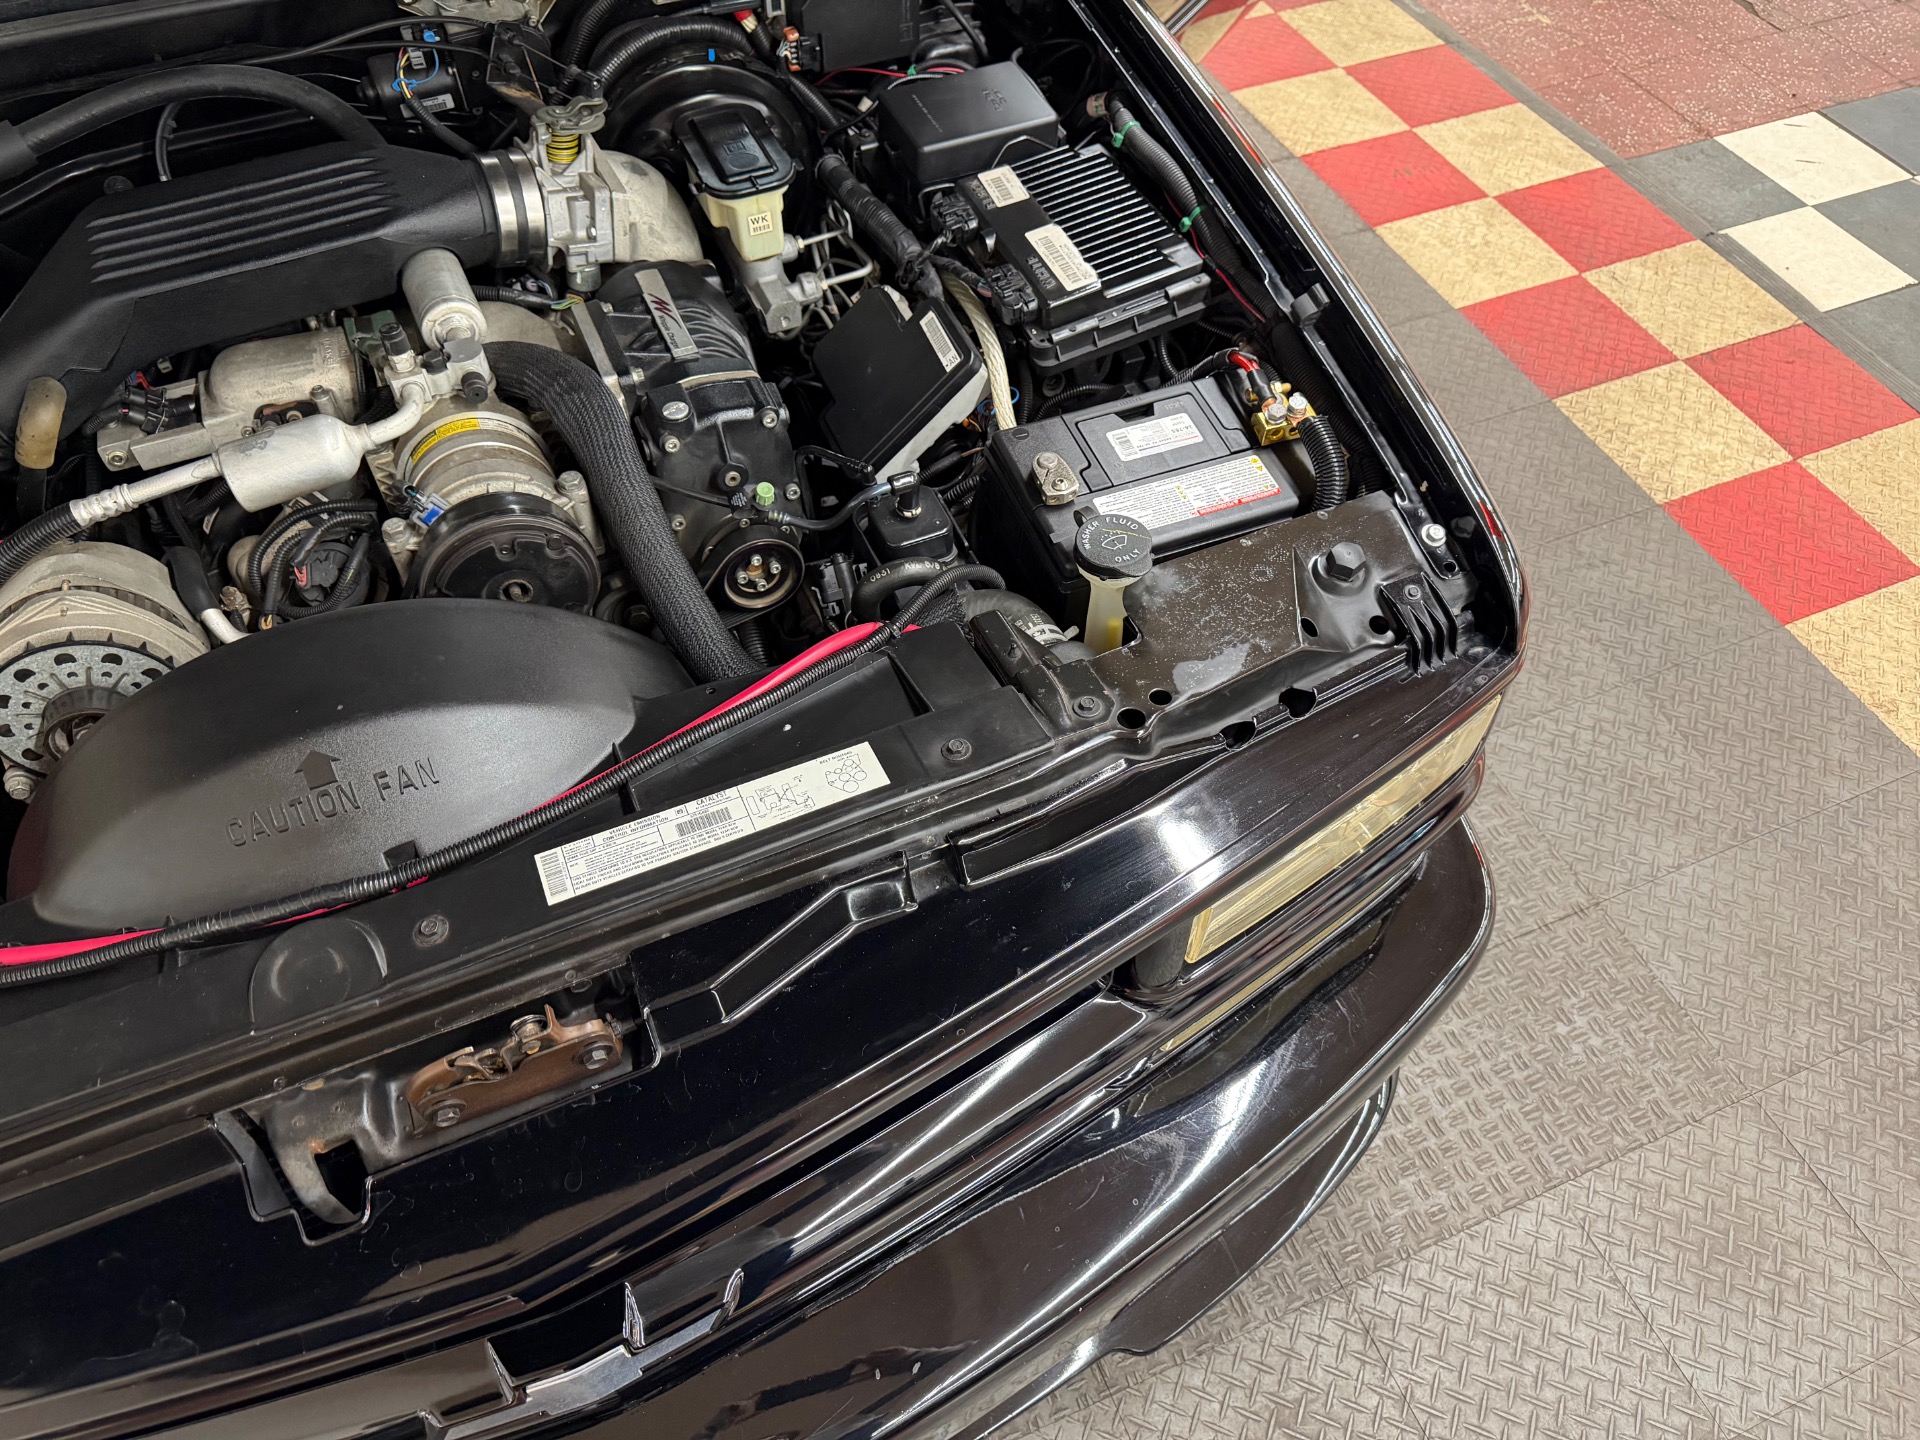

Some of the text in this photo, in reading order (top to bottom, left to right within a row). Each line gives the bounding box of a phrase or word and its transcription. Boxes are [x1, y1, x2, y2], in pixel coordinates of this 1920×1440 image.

[750, 214, 769, 226] WK
[1105, 516, 1139, 530] FLUID
[1081, 520, 1100, 550] WASHER
[1114, 548, 1141, 563] ONLY
[225, 757, 440, 847] CAUTION FAN
[695, 790, 727, 805] CATALYST
[601, 815, 669, 842] CONTROL INFORMATION
[608, 813, 661, 835] VEHICLE EMISSION
